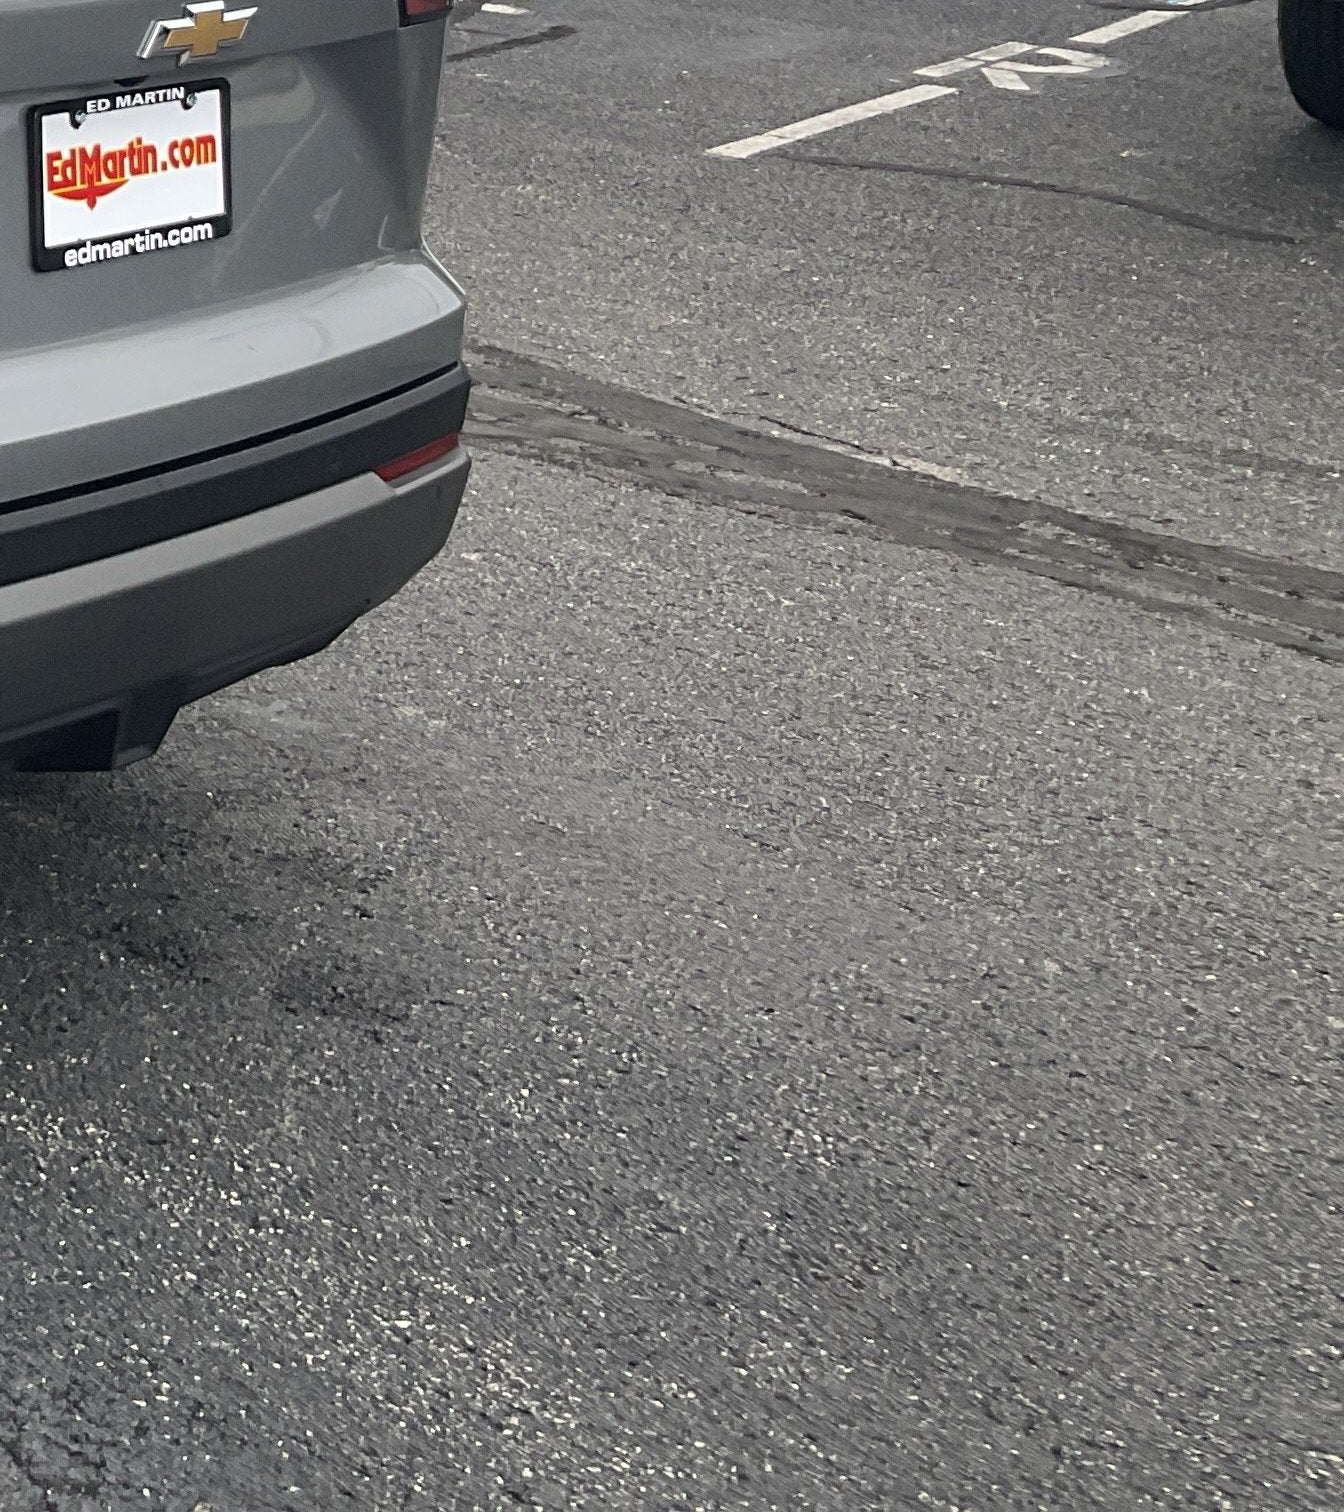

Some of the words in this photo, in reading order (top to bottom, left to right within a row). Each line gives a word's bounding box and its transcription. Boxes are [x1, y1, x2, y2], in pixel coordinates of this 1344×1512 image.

[86, 99, 111, 114] ED
[115, 86, 185, 109] MARTIN
[64, 222, 213, 267] edmartin.com
